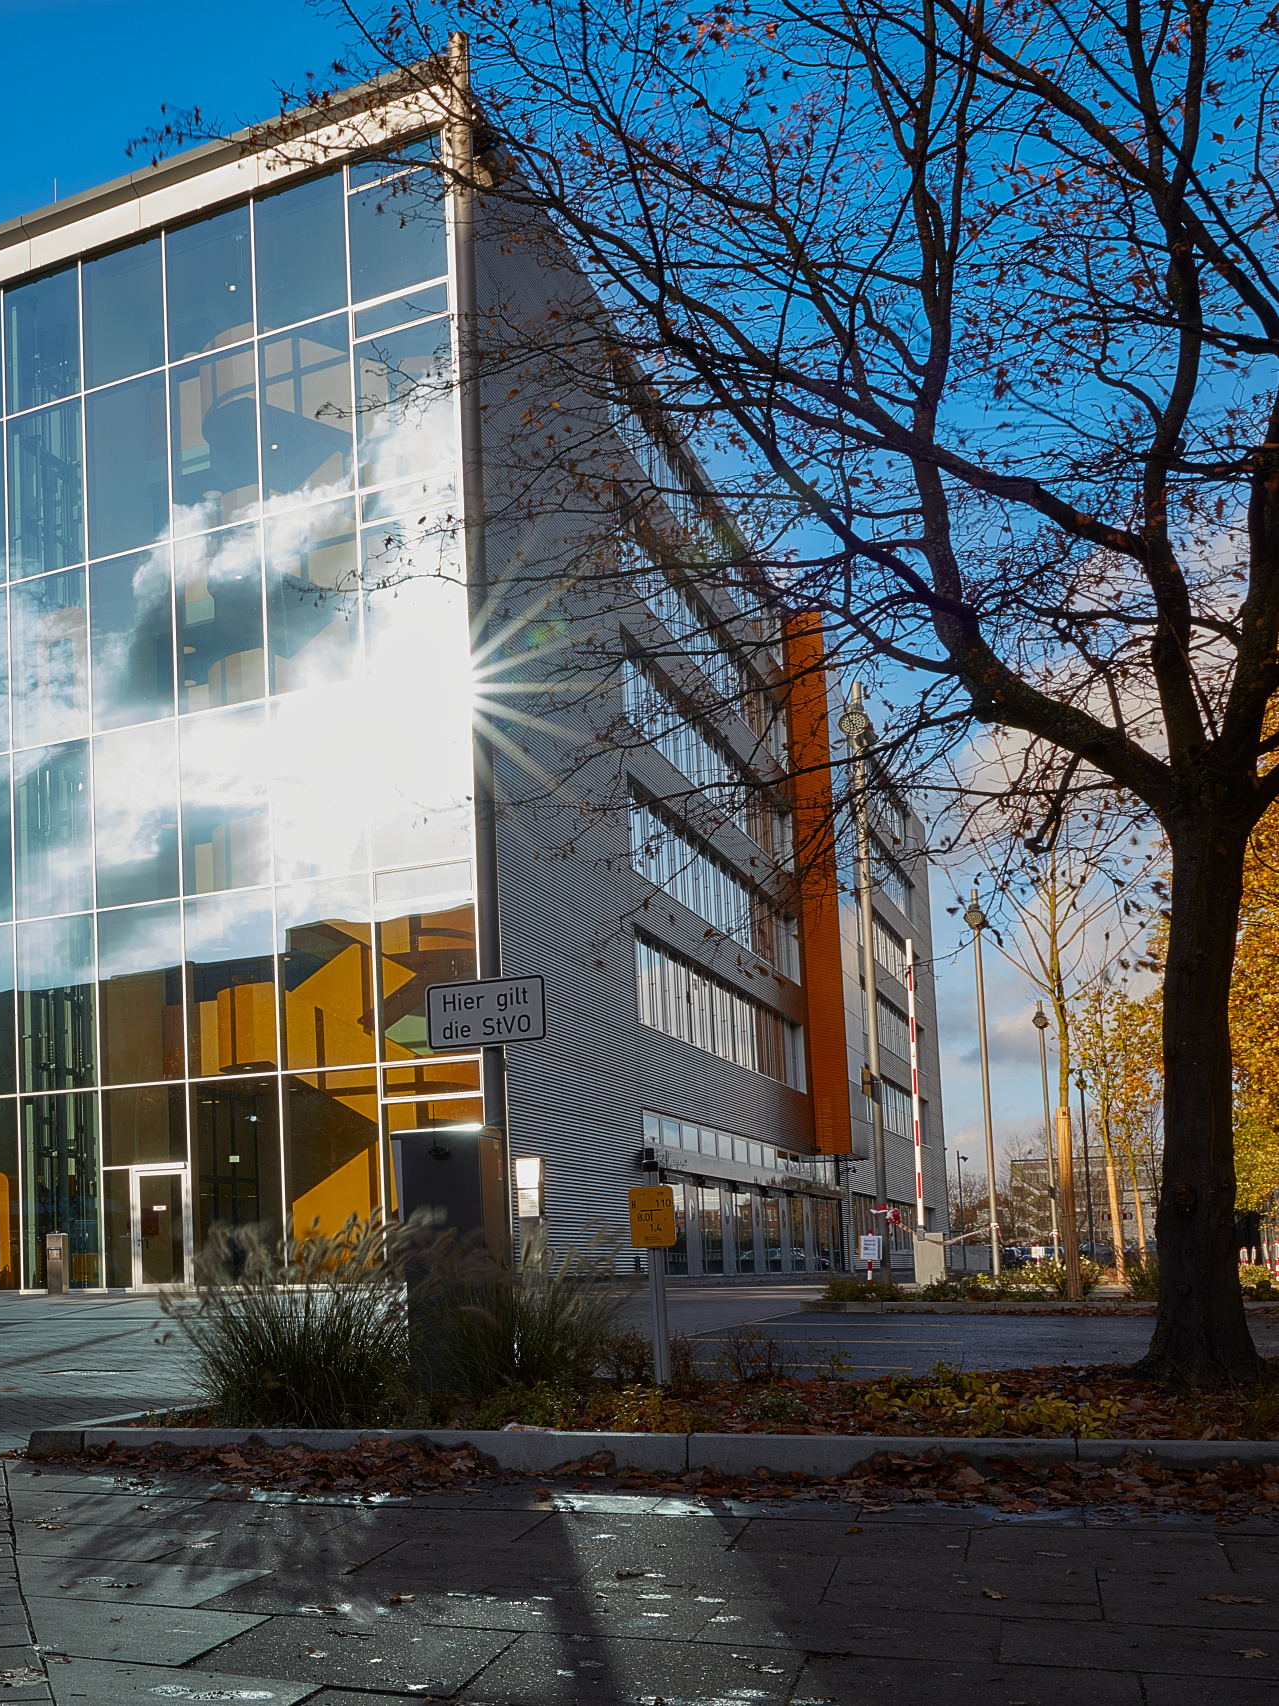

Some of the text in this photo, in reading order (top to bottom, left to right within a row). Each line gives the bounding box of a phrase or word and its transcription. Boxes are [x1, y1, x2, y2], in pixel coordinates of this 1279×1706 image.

[442, 986, 528, 1012] Hier gilt
[442, 1013, 531, 1039] die StVO
[631, 1198, 671, 1209] H 110
[637, 1212, 650, 1222] 8.0
[650, 1223, 662, 1232] 1.4
